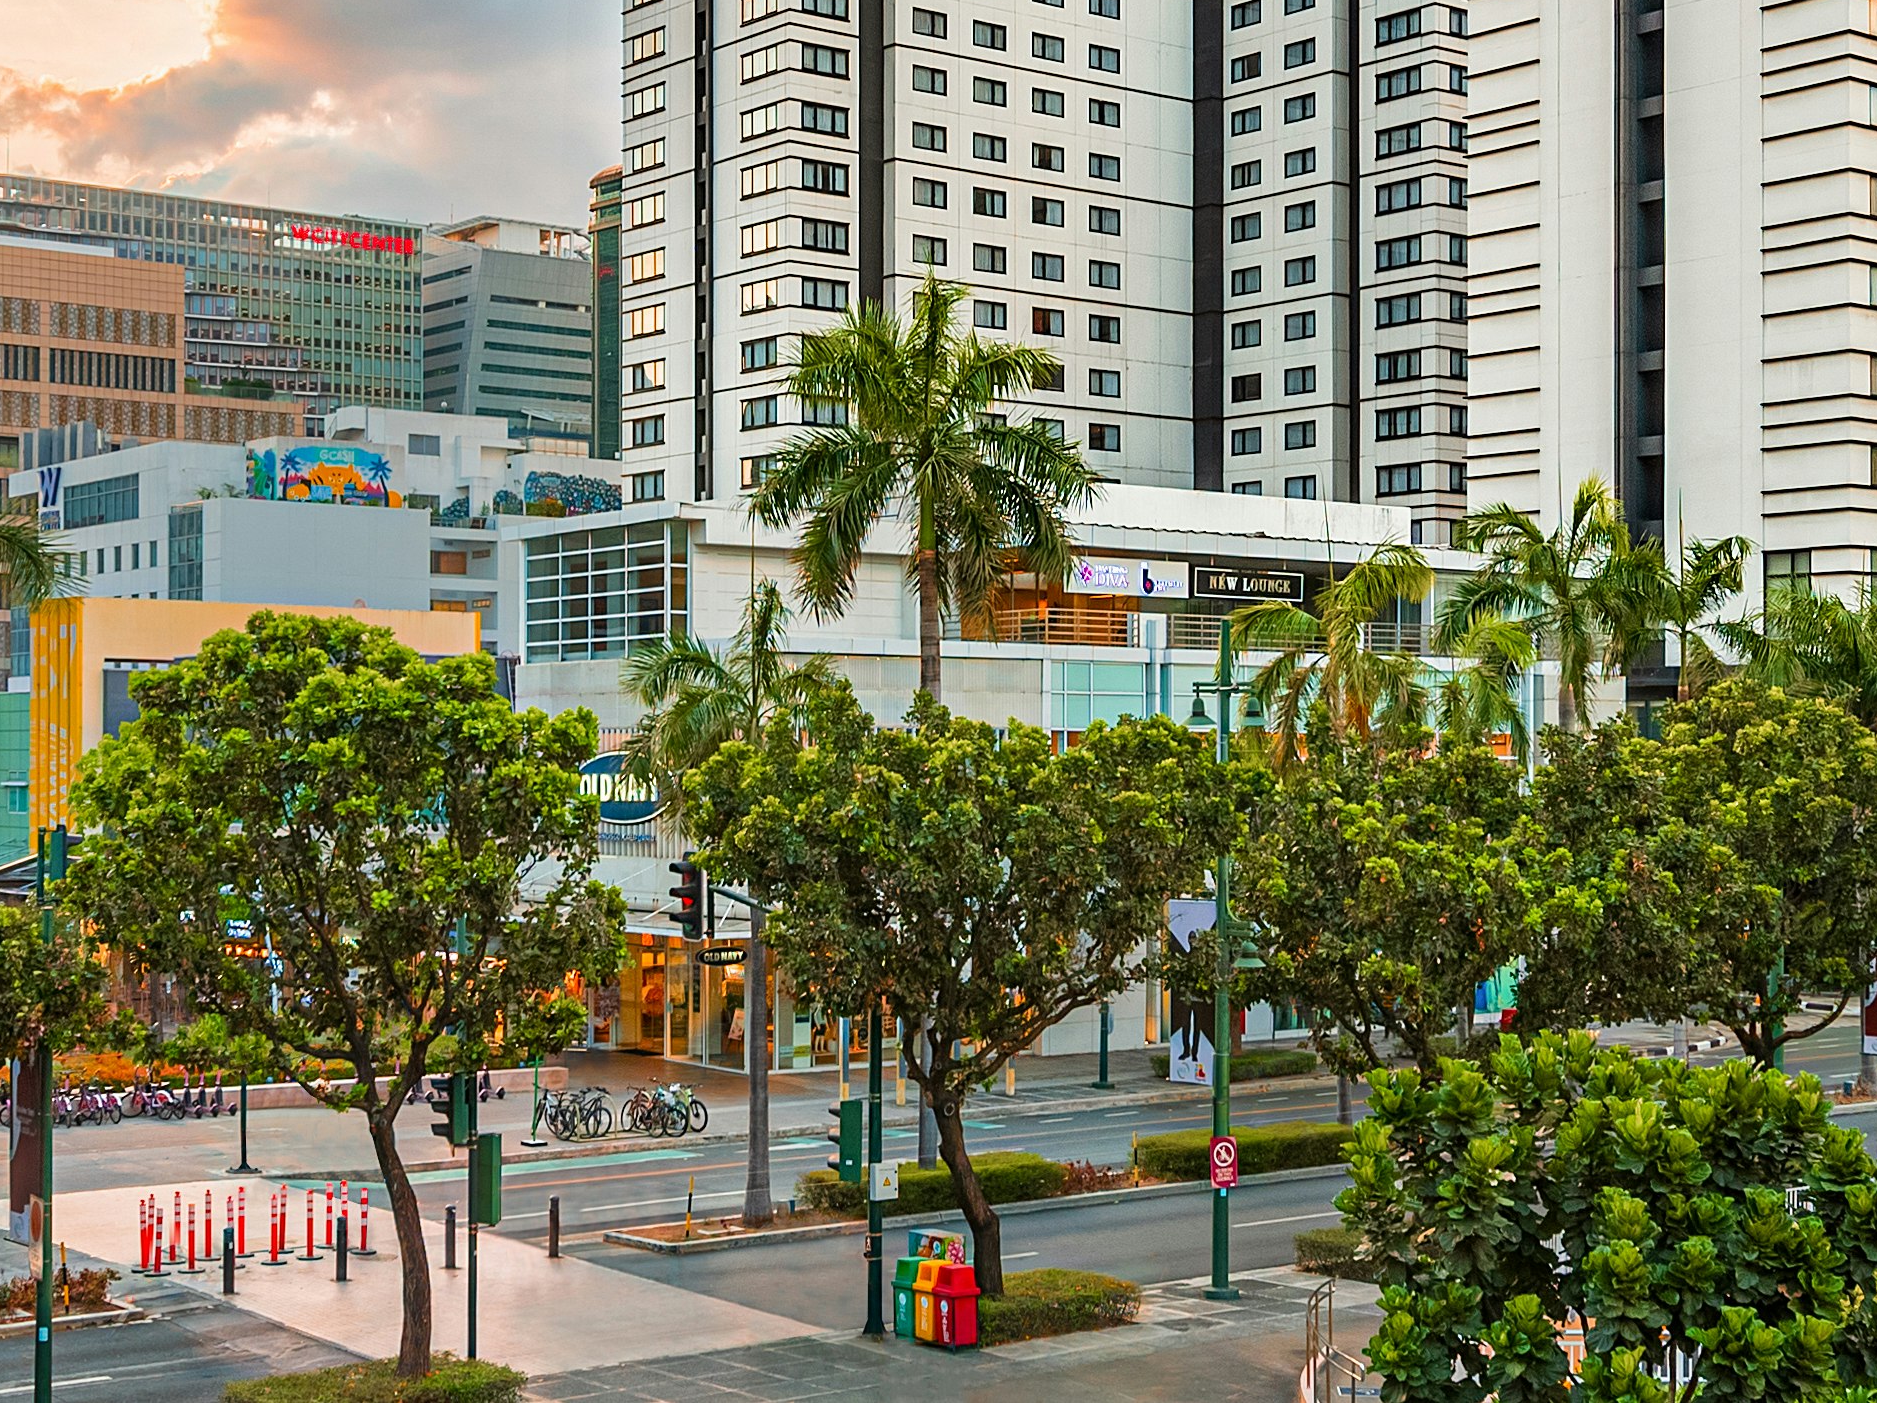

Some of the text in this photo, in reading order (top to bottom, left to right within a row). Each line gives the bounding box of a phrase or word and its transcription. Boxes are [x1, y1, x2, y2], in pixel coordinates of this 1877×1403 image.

[39, 467, 61, 507] W
[1095, 573, 1129, 588] DIVA
[1243, 578, 1291, 593] LOUNGE
[704, 951, 743, 962] OLD NAVY
